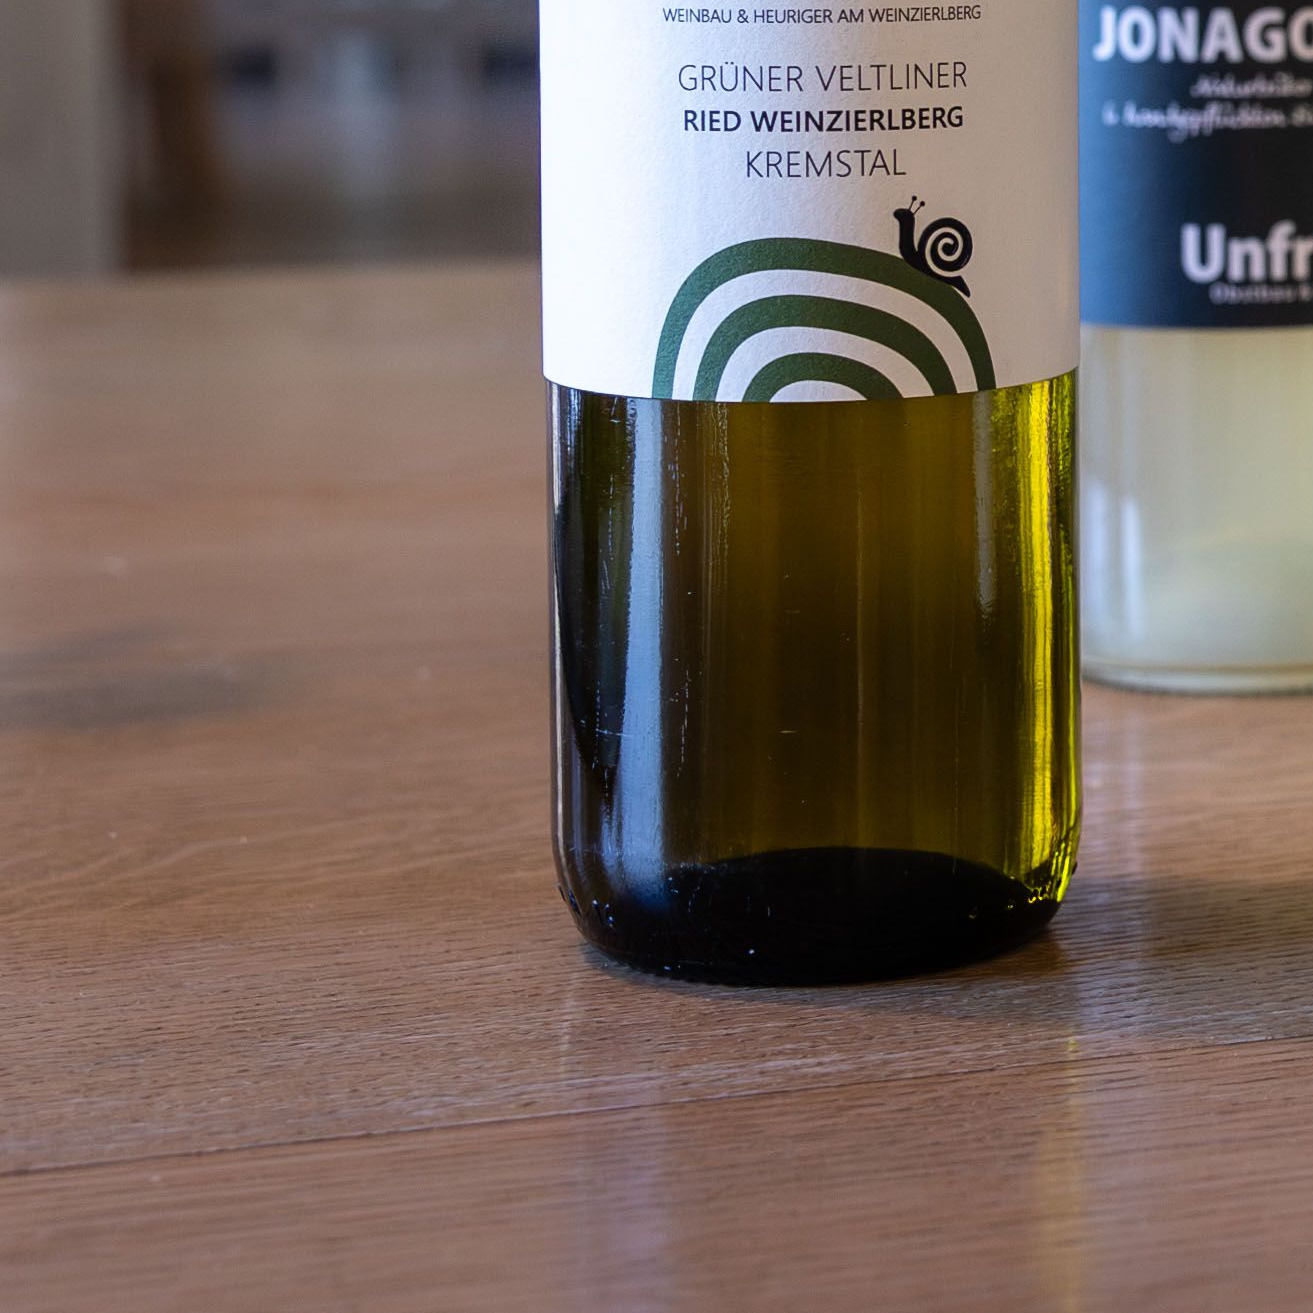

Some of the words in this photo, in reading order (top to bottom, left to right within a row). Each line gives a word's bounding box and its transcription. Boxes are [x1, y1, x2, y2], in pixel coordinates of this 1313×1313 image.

[663, 8, 731, 23] WEINBAU
[737, 9, 748, 23] &
[754, 9, 833, 23] HEURIGER
[837, 9, 864, 23] AM
[868, 5, 981, 22] WEINZIERLBERG
[679, 62, 804, 92] GRÜNER
[815, 62, 966, 91] VELTLINER
[684, 110, 741, 132] RIED
[750, 106, 963, 132] WEINZIERLBERG
[747, 149, 906, 178] KREMSTAL
